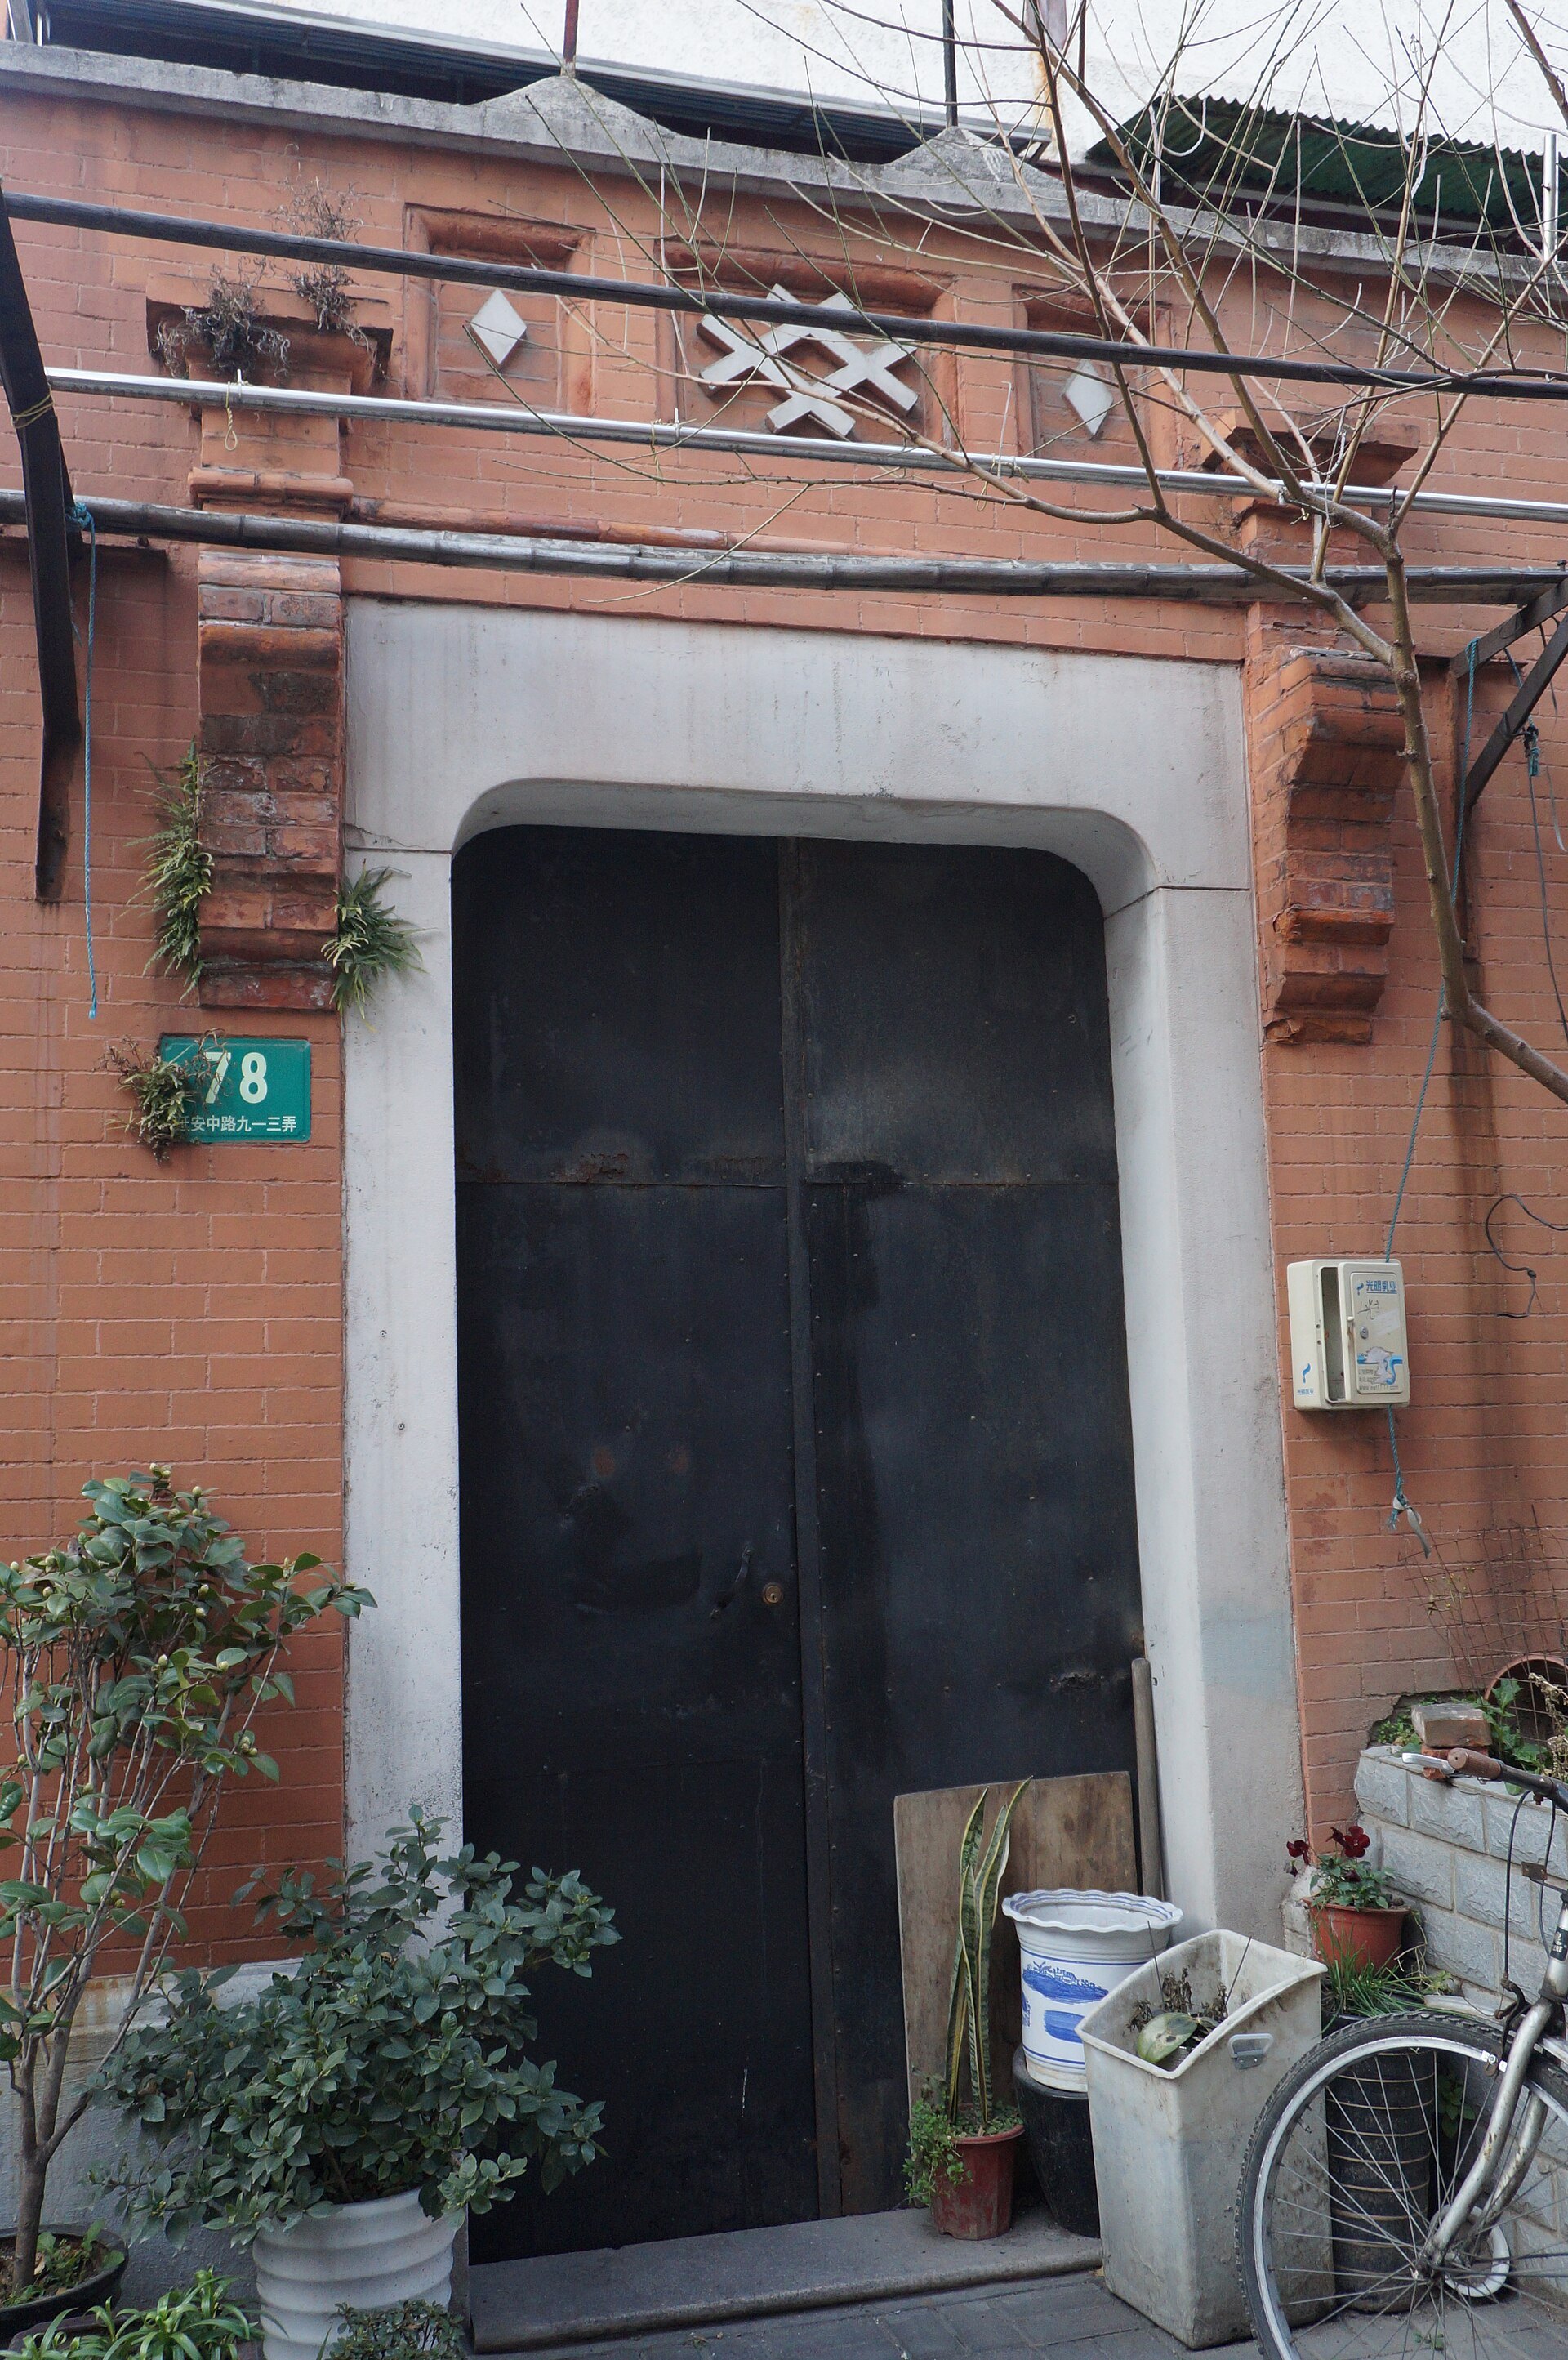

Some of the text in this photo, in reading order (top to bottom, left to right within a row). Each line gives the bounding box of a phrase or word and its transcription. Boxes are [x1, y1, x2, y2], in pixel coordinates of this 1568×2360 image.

[204, 1051, 268, 1104] 78
[1366, 1280, 1397, 1292] 光明乳业
